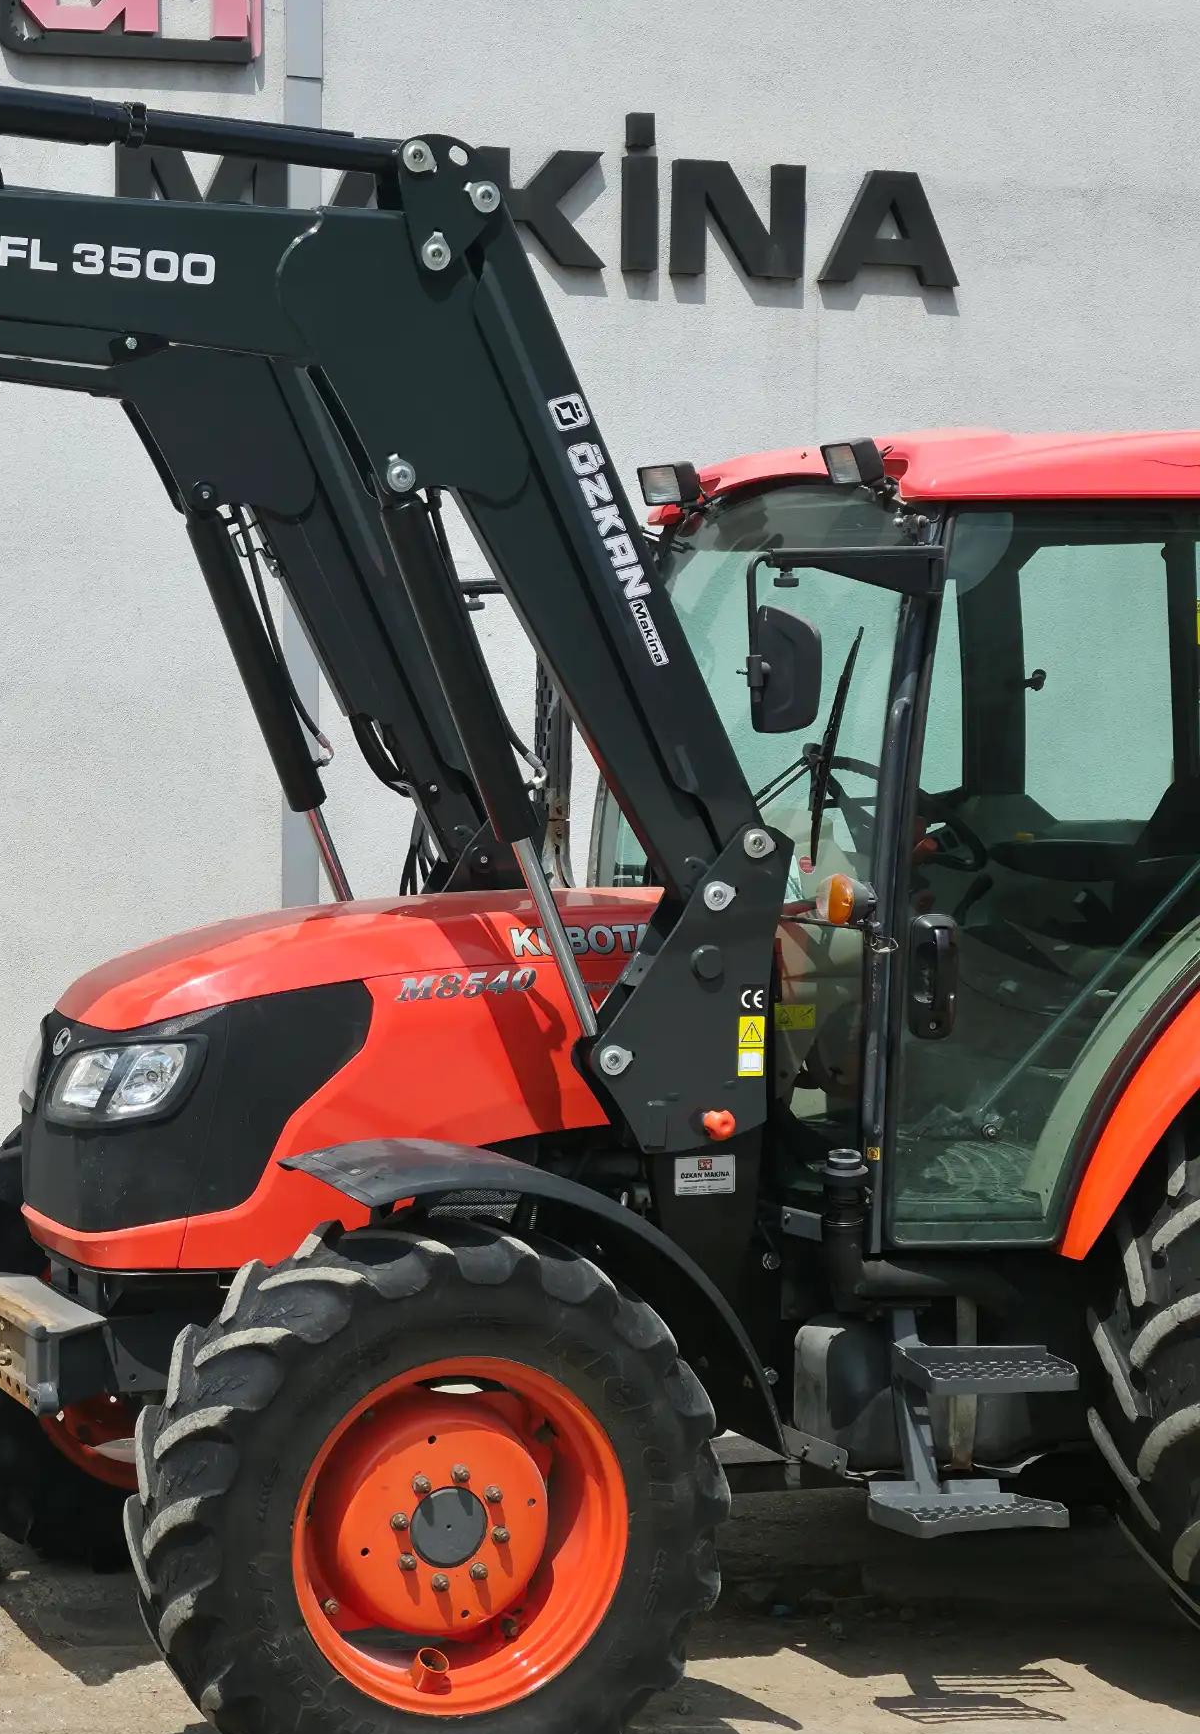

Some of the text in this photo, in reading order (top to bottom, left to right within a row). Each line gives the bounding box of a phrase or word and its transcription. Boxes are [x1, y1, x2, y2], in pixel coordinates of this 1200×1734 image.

[114, 112, 961, 288] MKİNA
[72, 242, 216, 285] 3500
[566, 441, 652, 600] ÖZKAN
[632, 602, 664, 665] Makina
[394, 966, 537, 1003] M8540
